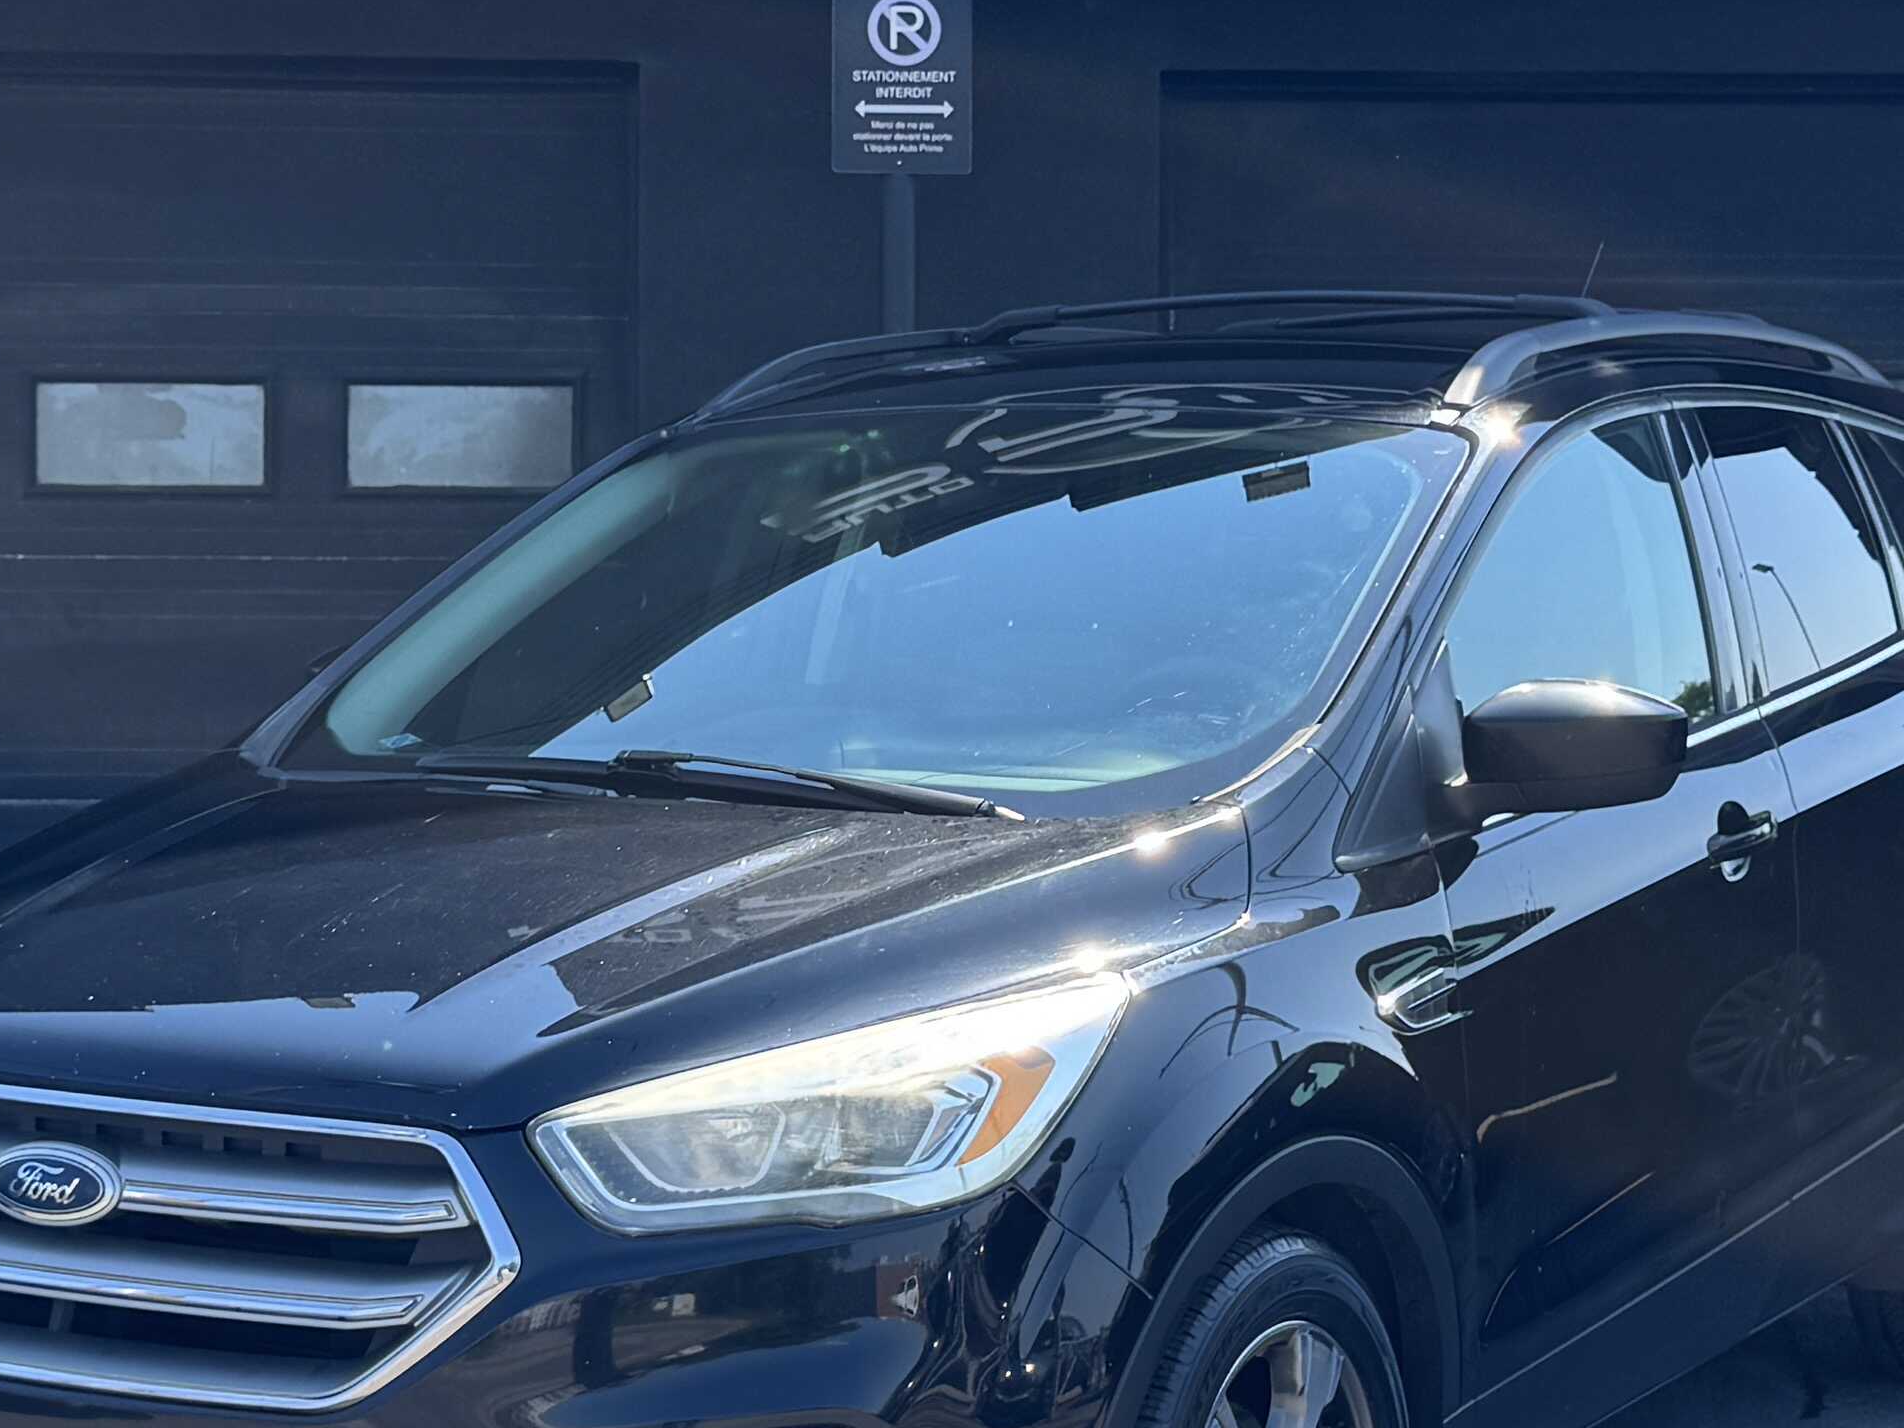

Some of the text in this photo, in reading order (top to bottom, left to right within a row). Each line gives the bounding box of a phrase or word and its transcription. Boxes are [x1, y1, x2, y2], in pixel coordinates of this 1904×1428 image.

[852, 70, 956, 83] STATIONNEMENT
[875, 87, 933, 98] INTERDIT
[10, 1162, 80, 1204] Ford
